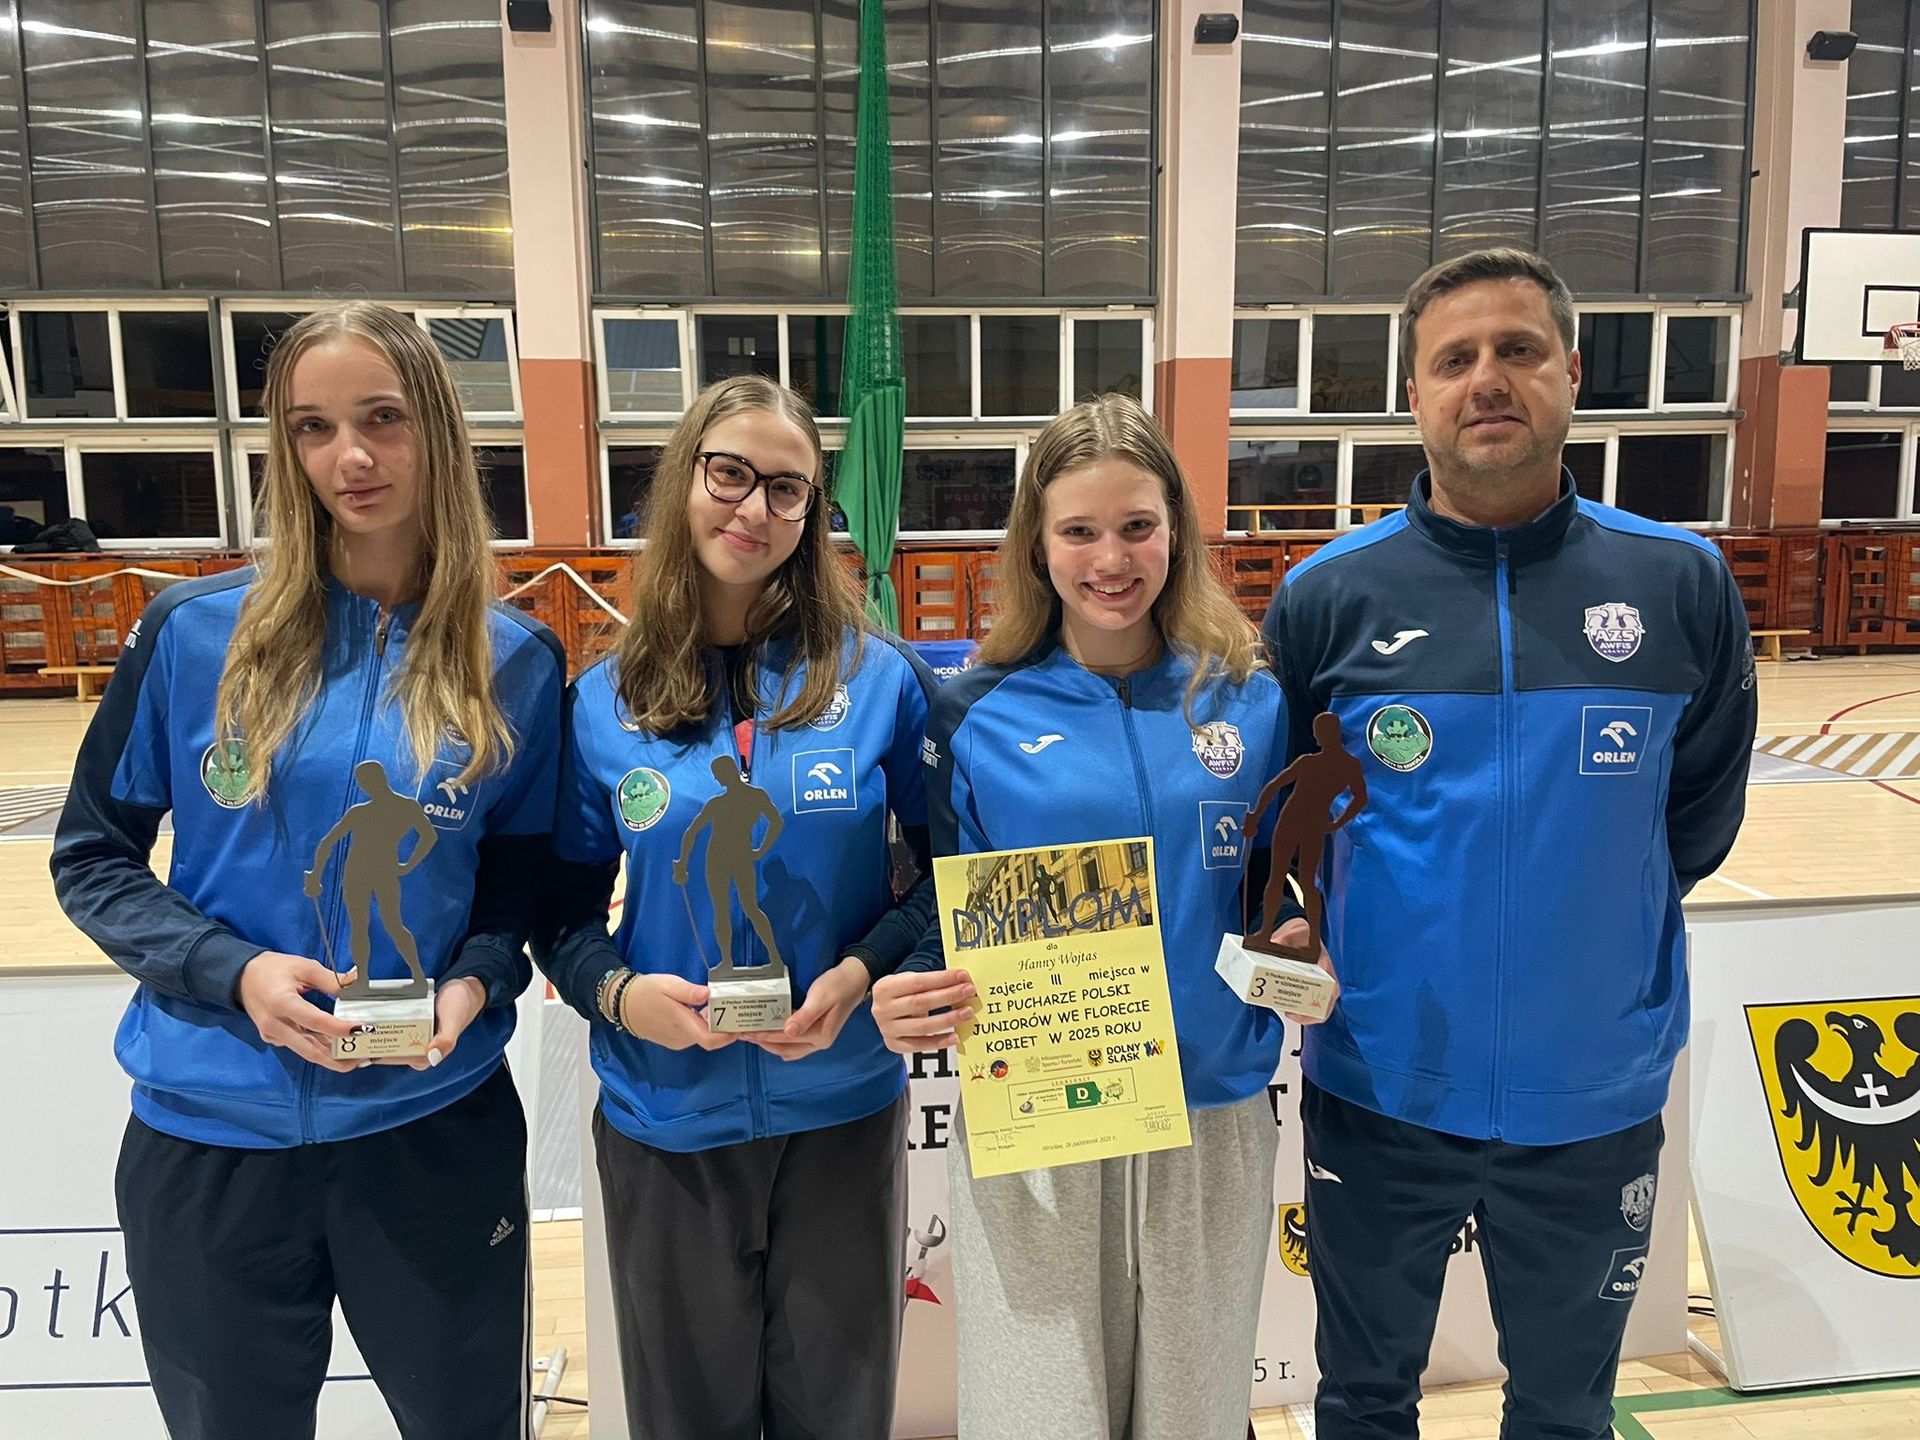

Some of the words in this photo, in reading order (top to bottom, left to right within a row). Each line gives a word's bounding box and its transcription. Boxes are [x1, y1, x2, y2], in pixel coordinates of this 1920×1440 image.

[1595, 629, 1635, 642] AZS
[1204, 747, 1237, 759] AZS
[1592, 751, 1636, 764] ORLEN
[803, 788, 848, 801] ORLEN
[423, 803, 465, 820] ORLEN
[952, 885, 1149, 948] DYPLOM
[1046, 943, 1058, 951] dla
[1018, 957, 1056, 972] Hanny
[1058, 950, 1098, 966] Wojtas
[989, 979, 1034, 997] zajęcie
[1088, 968, 1136, 982] miejsca
[1140, 964, 1150, 973] w
[1251, 977, 1267, 998] 3
[987, 1002, 1002, 1015] II
[1007, 990, 1077, 1012] PUCHARZE
[1082, 984, 1132, 1000] POLSKI
[713, 1007, 726, 1026] 7
[973, 1013, 1051, 1036] JUNIORÓW
[1057, 1010, 1080, 1024] WE
[1085, 1000, 1151, 1020] FLORECIE
[986, 1035, 1038, 1054] KOBIET
[1049, 1032, 1063, 1044] W
[1068, 1026, 1100, 1042] 2025
[1105, 1021, 1142, 1036] ROKU
[1106, 1043, 1141, 1055] DOLNY
[1278, 1360, 1296, 1380] r.
